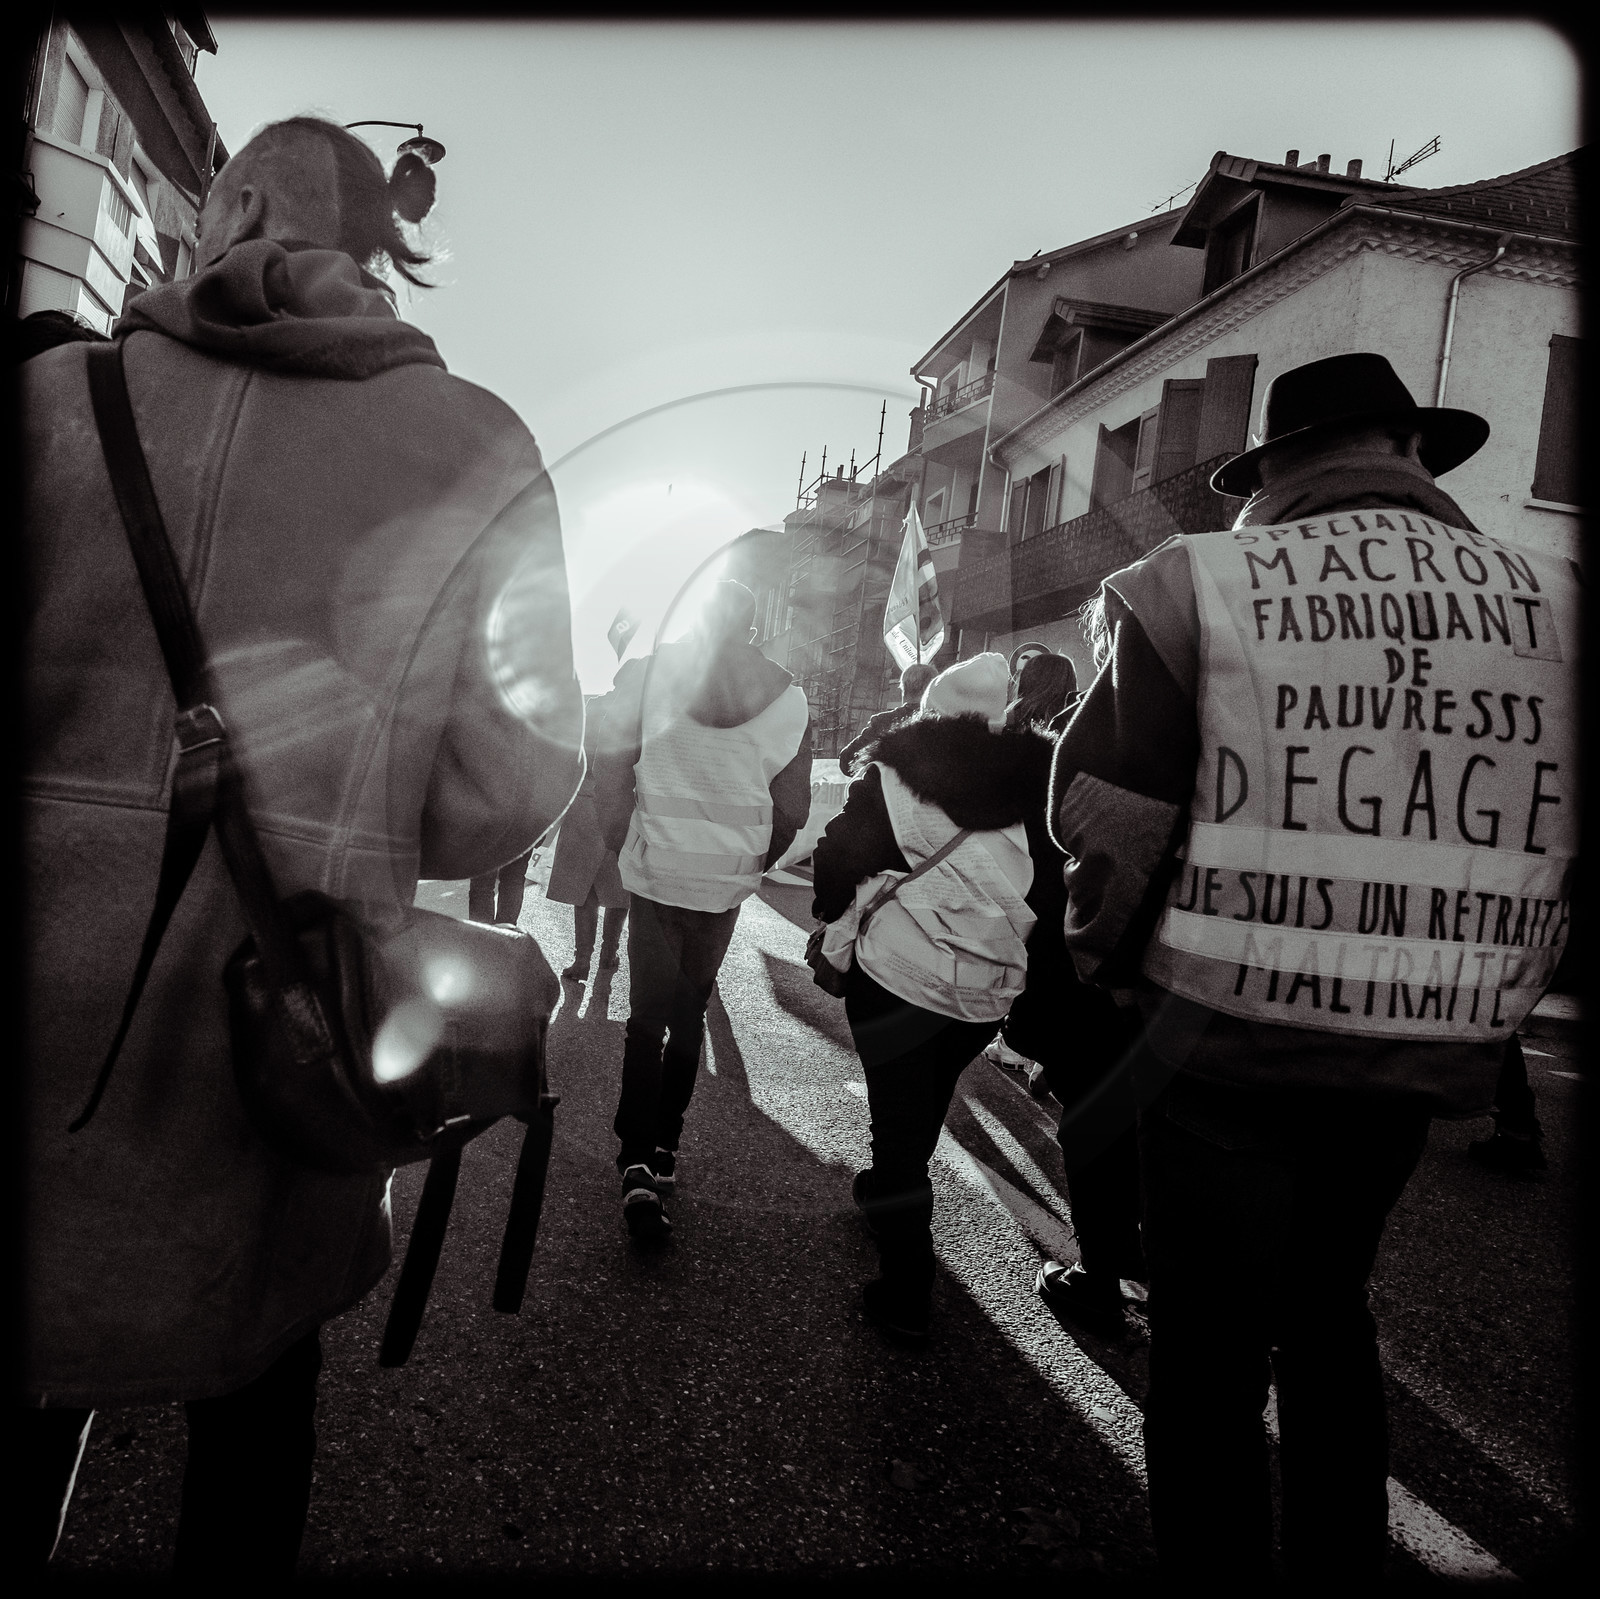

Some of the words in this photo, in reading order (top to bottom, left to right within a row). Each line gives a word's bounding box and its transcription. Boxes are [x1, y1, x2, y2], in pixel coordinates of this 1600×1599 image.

[1243, 537, 1541, 593] MACRON
[1253, 590, 1542, 648] FABRIQUANT
[1384, 647, 1432, 687] DE
[1276, 683, 1544, 745] PAUVRESSS
[1214, 745, 1561, 855] DEGAGE
[1176, 866, 1223, 916] JE
[1233, 871, 1334, 930] SUIS
[1357, 882, 1408, 937] UN
[1234, 932, 1521, 1028] MALTRAITE
